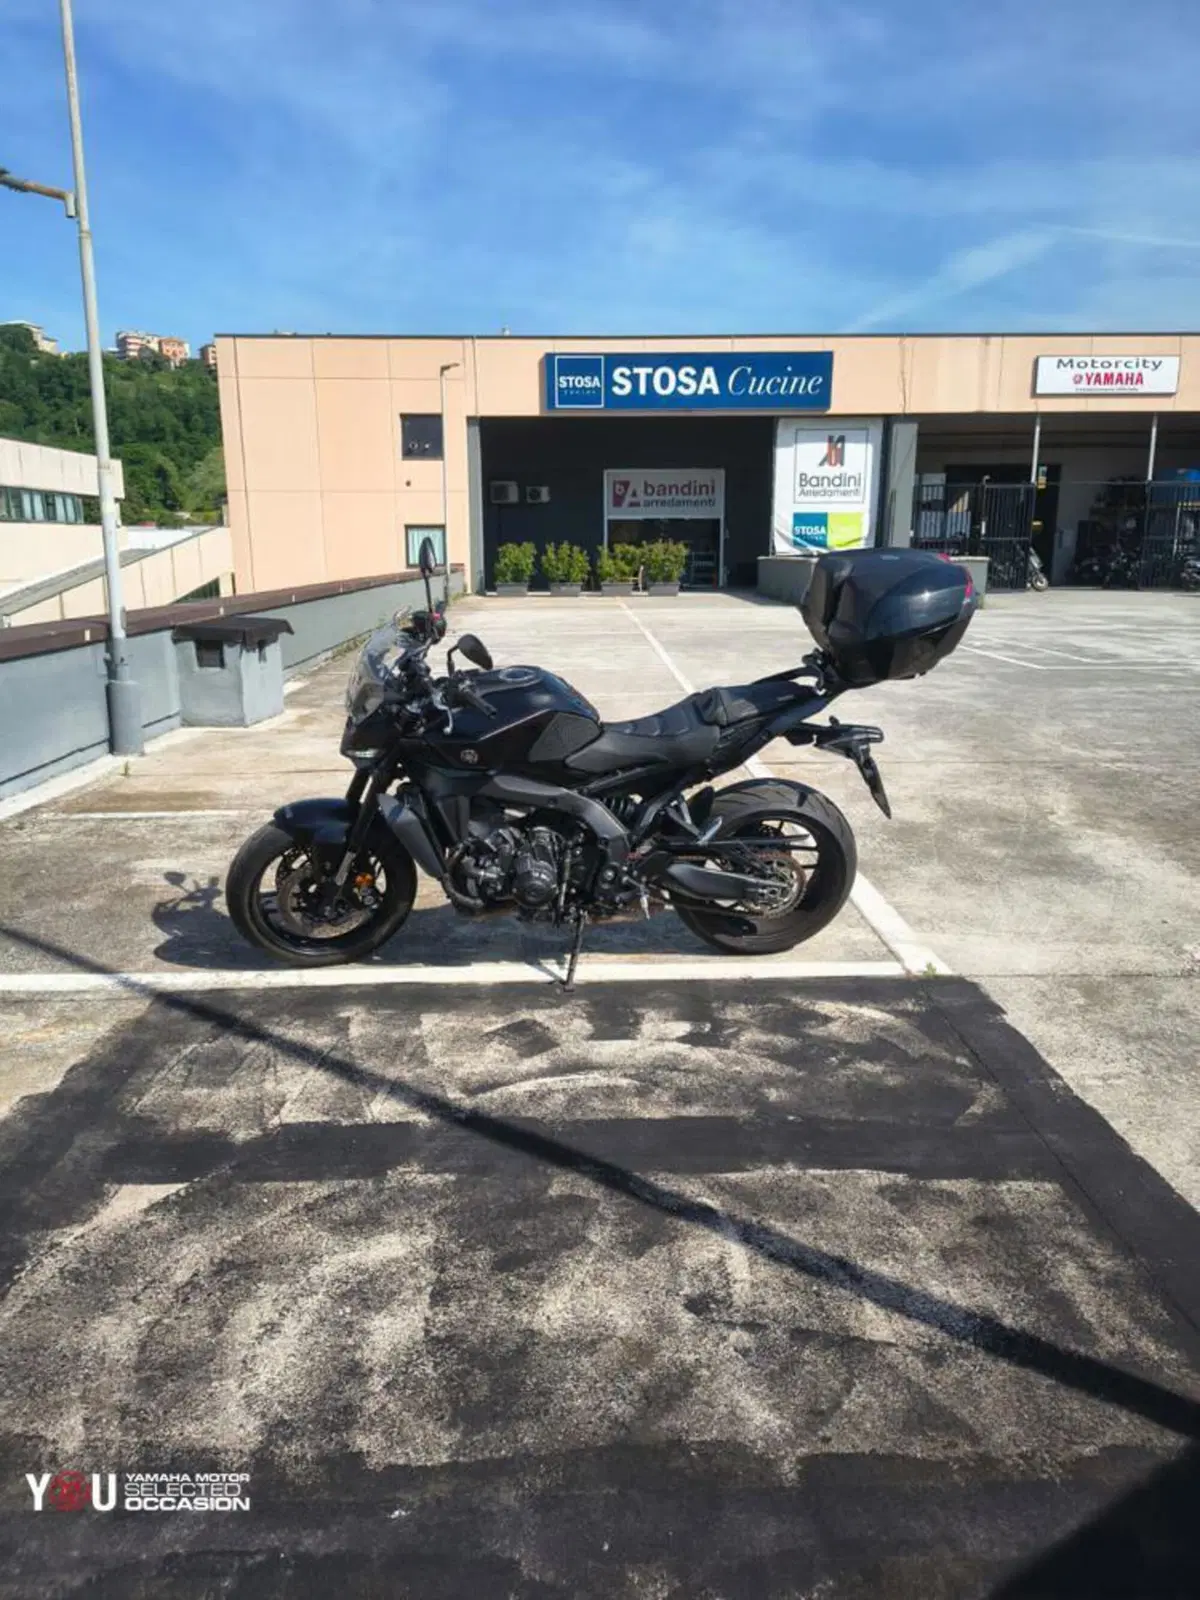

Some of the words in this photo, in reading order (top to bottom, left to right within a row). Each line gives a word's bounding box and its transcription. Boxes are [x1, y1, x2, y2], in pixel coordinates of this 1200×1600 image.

[1056, 358, 1163, 371] Motorcity
[559, 375, 600, 388] STOSA
[611, 366, 720, 395] STOSA
[727, 366, 823, 395] Cucine
[1085, 372, 1144, 386] YAMAHA
[799, 473, 861, 488] Bandini
[643, 479, 716, 497] bandini
[798, 488, 860, 498] Arredamenti
[643, 497, 716, 508] arredamenti
[794, 526, 826, 535] STOSA
